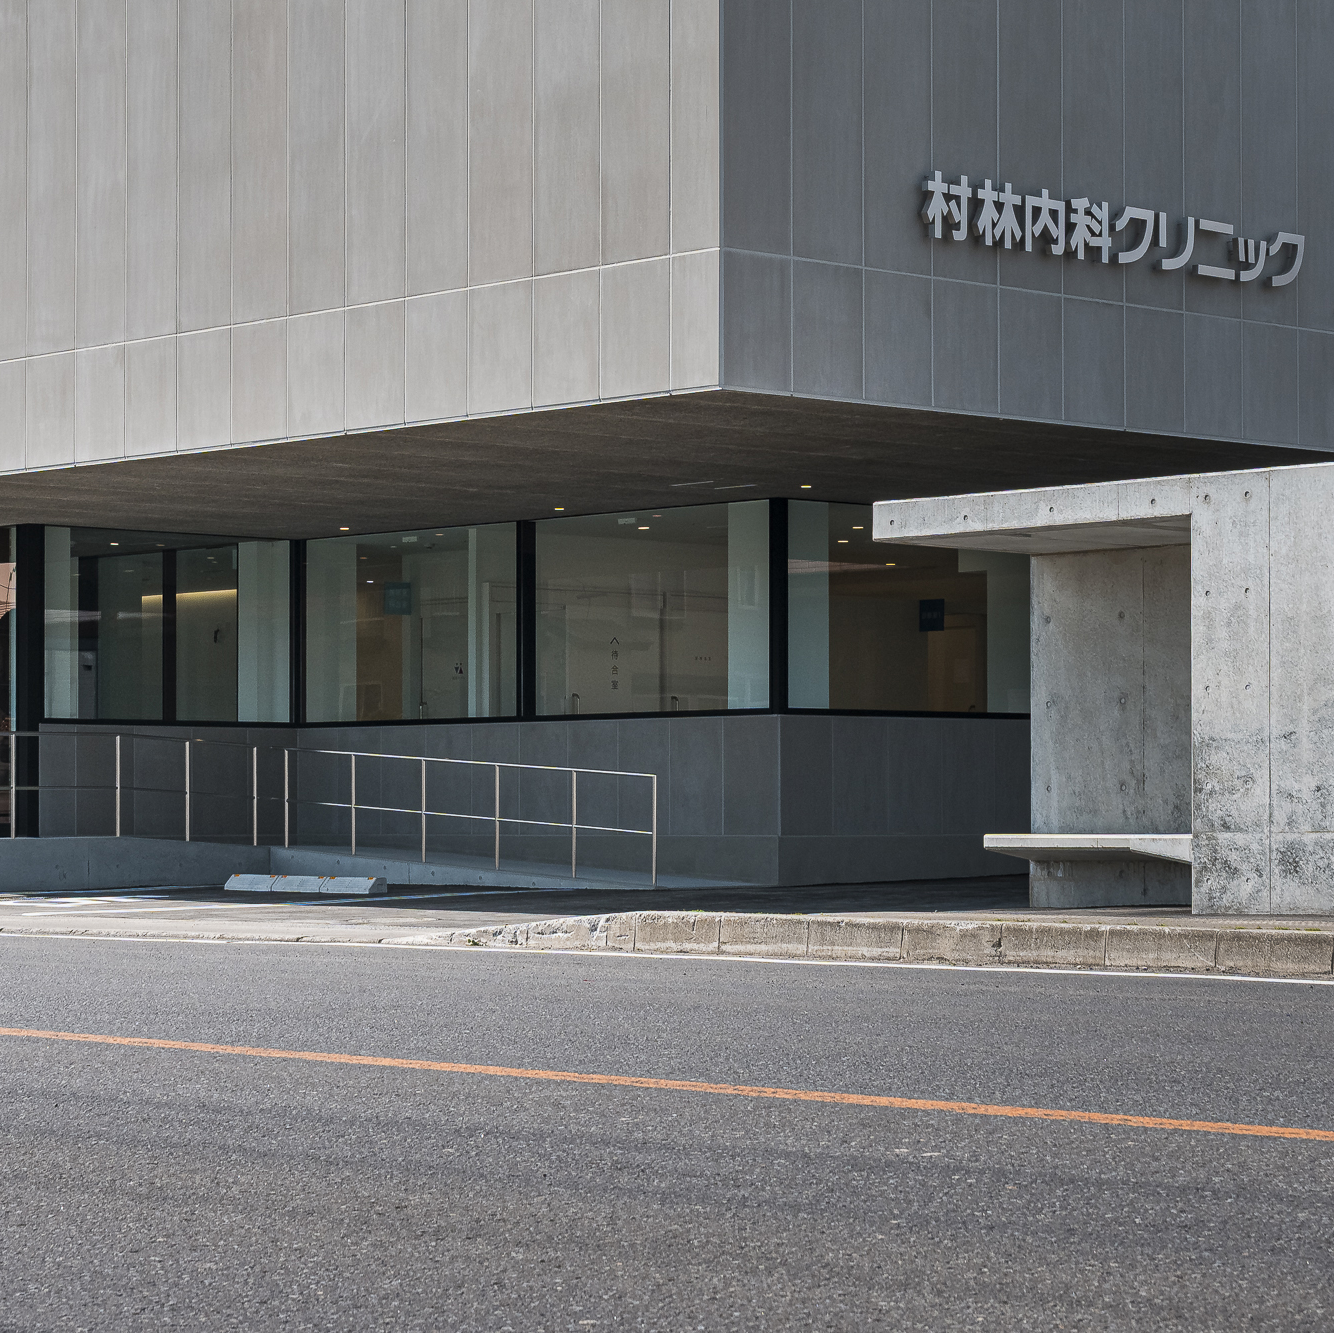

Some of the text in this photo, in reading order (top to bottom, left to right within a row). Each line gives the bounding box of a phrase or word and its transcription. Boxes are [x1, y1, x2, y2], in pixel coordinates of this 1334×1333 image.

[922, 171, 1305, 287] 村林内科クリニック
[611, 649, 619, 690] 待合室
